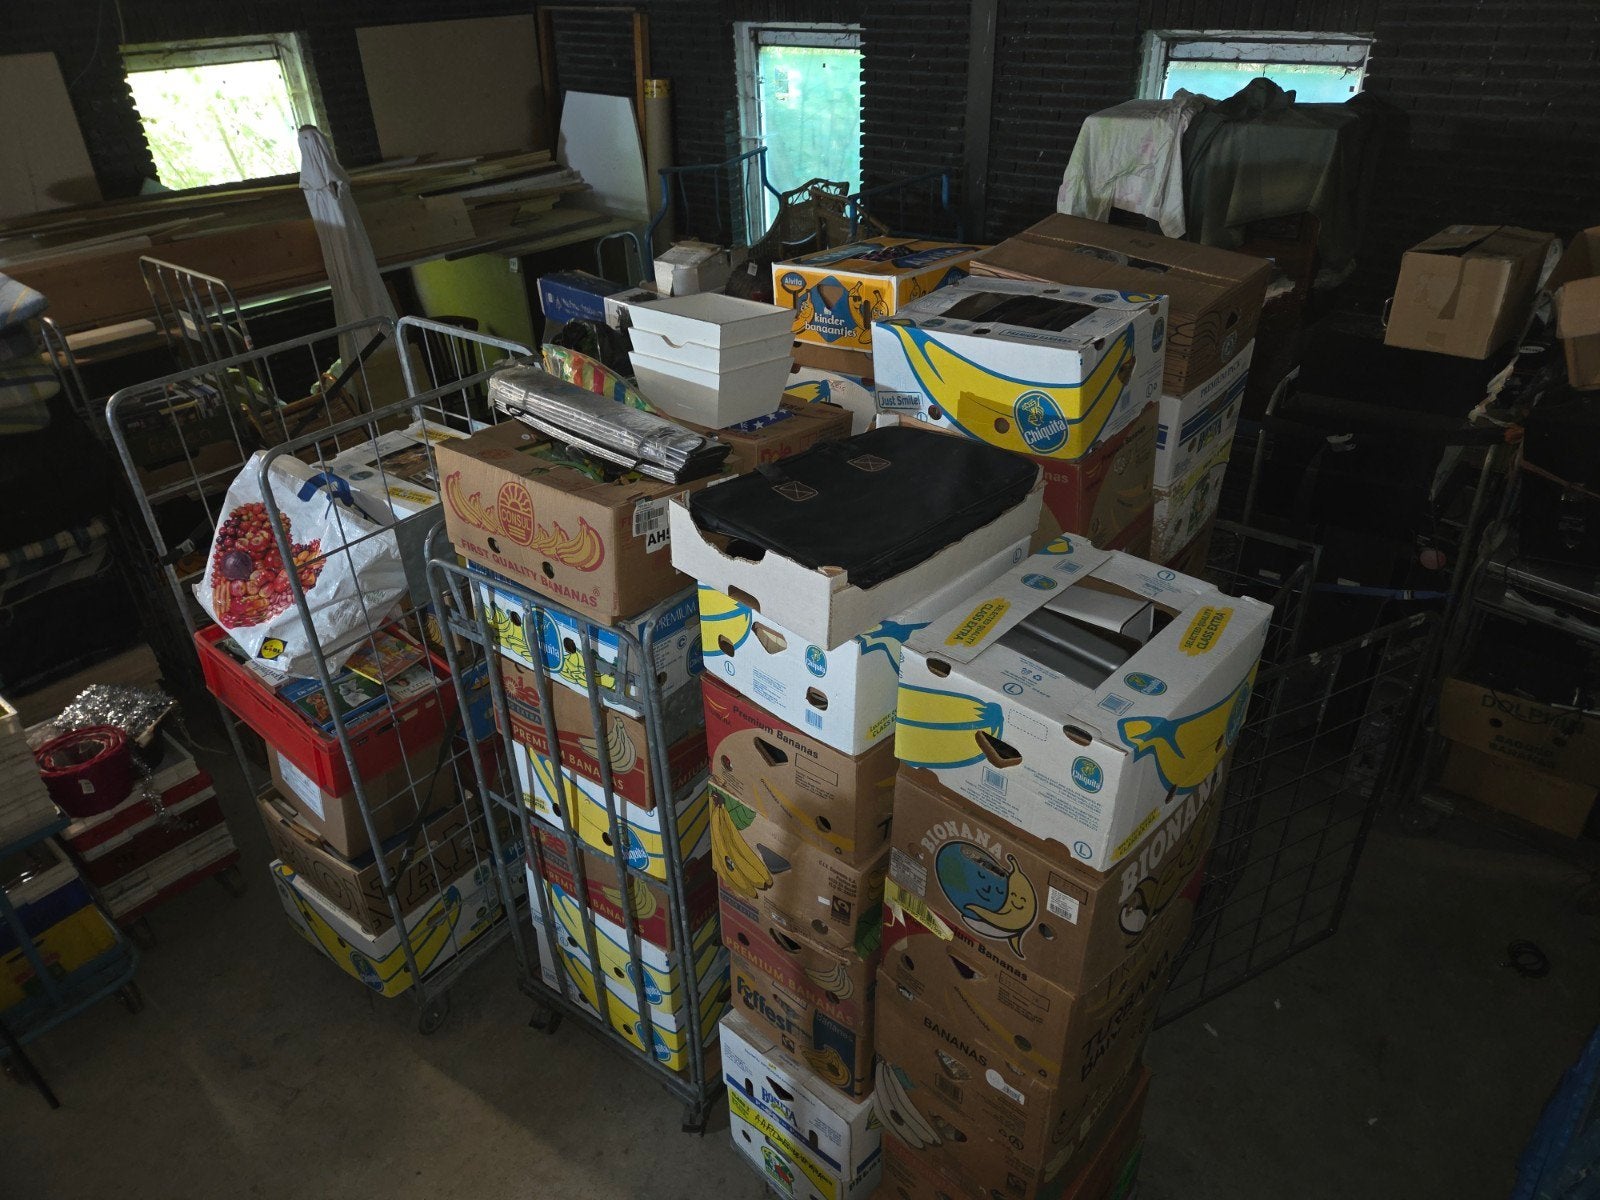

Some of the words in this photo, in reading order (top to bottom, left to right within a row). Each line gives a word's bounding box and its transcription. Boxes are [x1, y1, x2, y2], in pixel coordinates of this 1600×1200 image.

[805, 321, 857, 338] banaantjes
[814, 312, 845, 326] kinder
[881, 395, 896, 406] Just
[897, 395, 921, 407] Smile!
[1024, 417, 1068, 446] Chiquita
[500, 510, 532, 532] CONSUL
[460, 539, 489, 559] FIRST
[492, 553, 538, 581] QUALITY
[540, 574, 598, 608] BANANAS
[956, 619, 978, 641] EXTRA
[974, 603, 995, 625] CLASS
[1197, 629, 1213, 650] CLASS
[1206, 611, 1225, 634] EXTRA
[733, 705, 774, 736] Premium
[776, 730, 819, 759] Bananas
[512, 724, 565, 759] PREMIM
[569, 755, 625, 791] BANAAS
[1072, 771, 1105, 792] Chiquita
[920, 820, 1002, 857] BIONANA
[593, 898, 645, 934] BANAS
[726, 936, 784, 983] PREMIUM
[978, 943, 1028, 981] Bananas
[923, 1017, 988, 1067] BANANAS
[761, 1086, 798, 1127] BONITA
